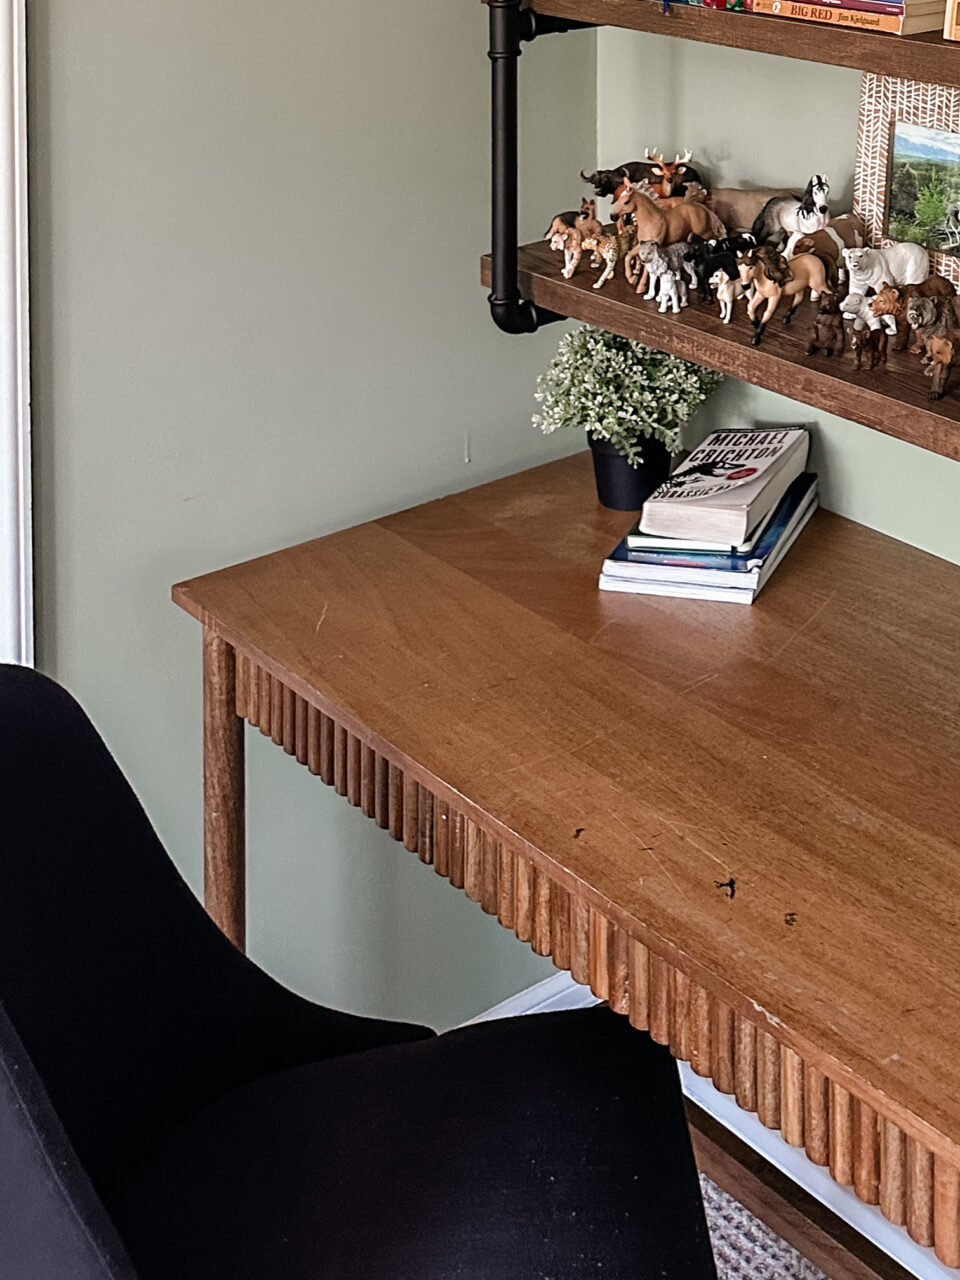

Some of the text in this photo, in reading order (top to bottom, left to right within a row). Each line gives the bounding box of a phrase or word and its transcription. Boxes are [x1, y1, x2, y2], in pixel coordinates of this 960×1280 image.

[790, 4, 832, 21] BIG RED
[837, 12, 880, 27] Jim Kjelgaard
[707, 432, 789, 447] MICHAEL
[689, 445, 784, 462] CRICHTON
[652, 488, 713, 499] JURASSIC
